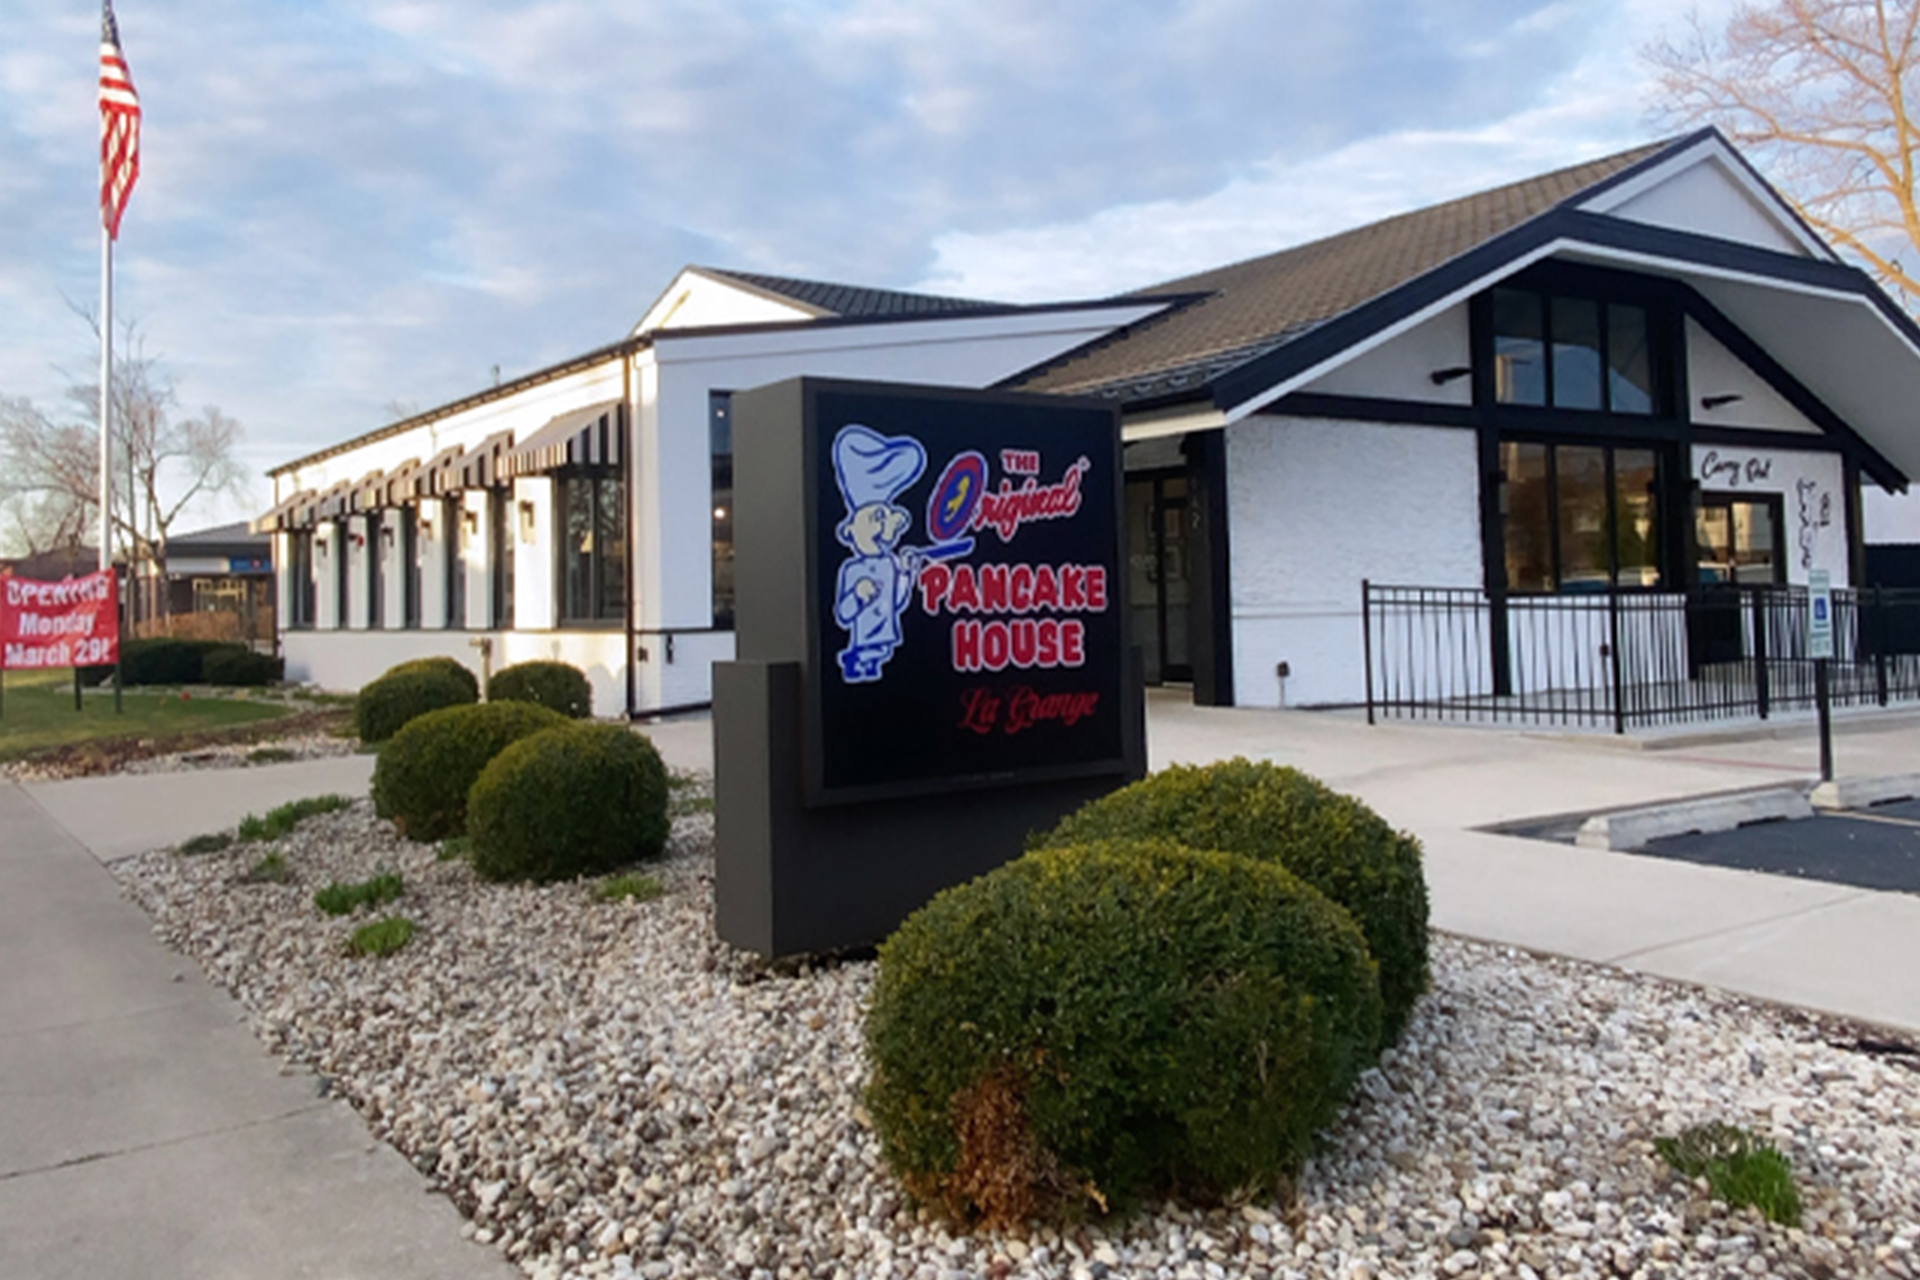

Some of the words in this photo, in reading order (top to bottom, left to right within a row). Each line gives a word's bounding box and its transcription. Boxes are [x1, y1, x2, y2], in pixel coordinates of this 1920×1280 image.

[1001, 450, 1040, 474] THE
[918, 563, 1107, 615] PANCAKE
[19, 612, 96, 636] Monday
[5, 641, 70, 666] March
[953, 618, 1085, 671] HOUSE
[957, 687, 1000, 734] La
[1004, 685, 1099, 734] Grange
